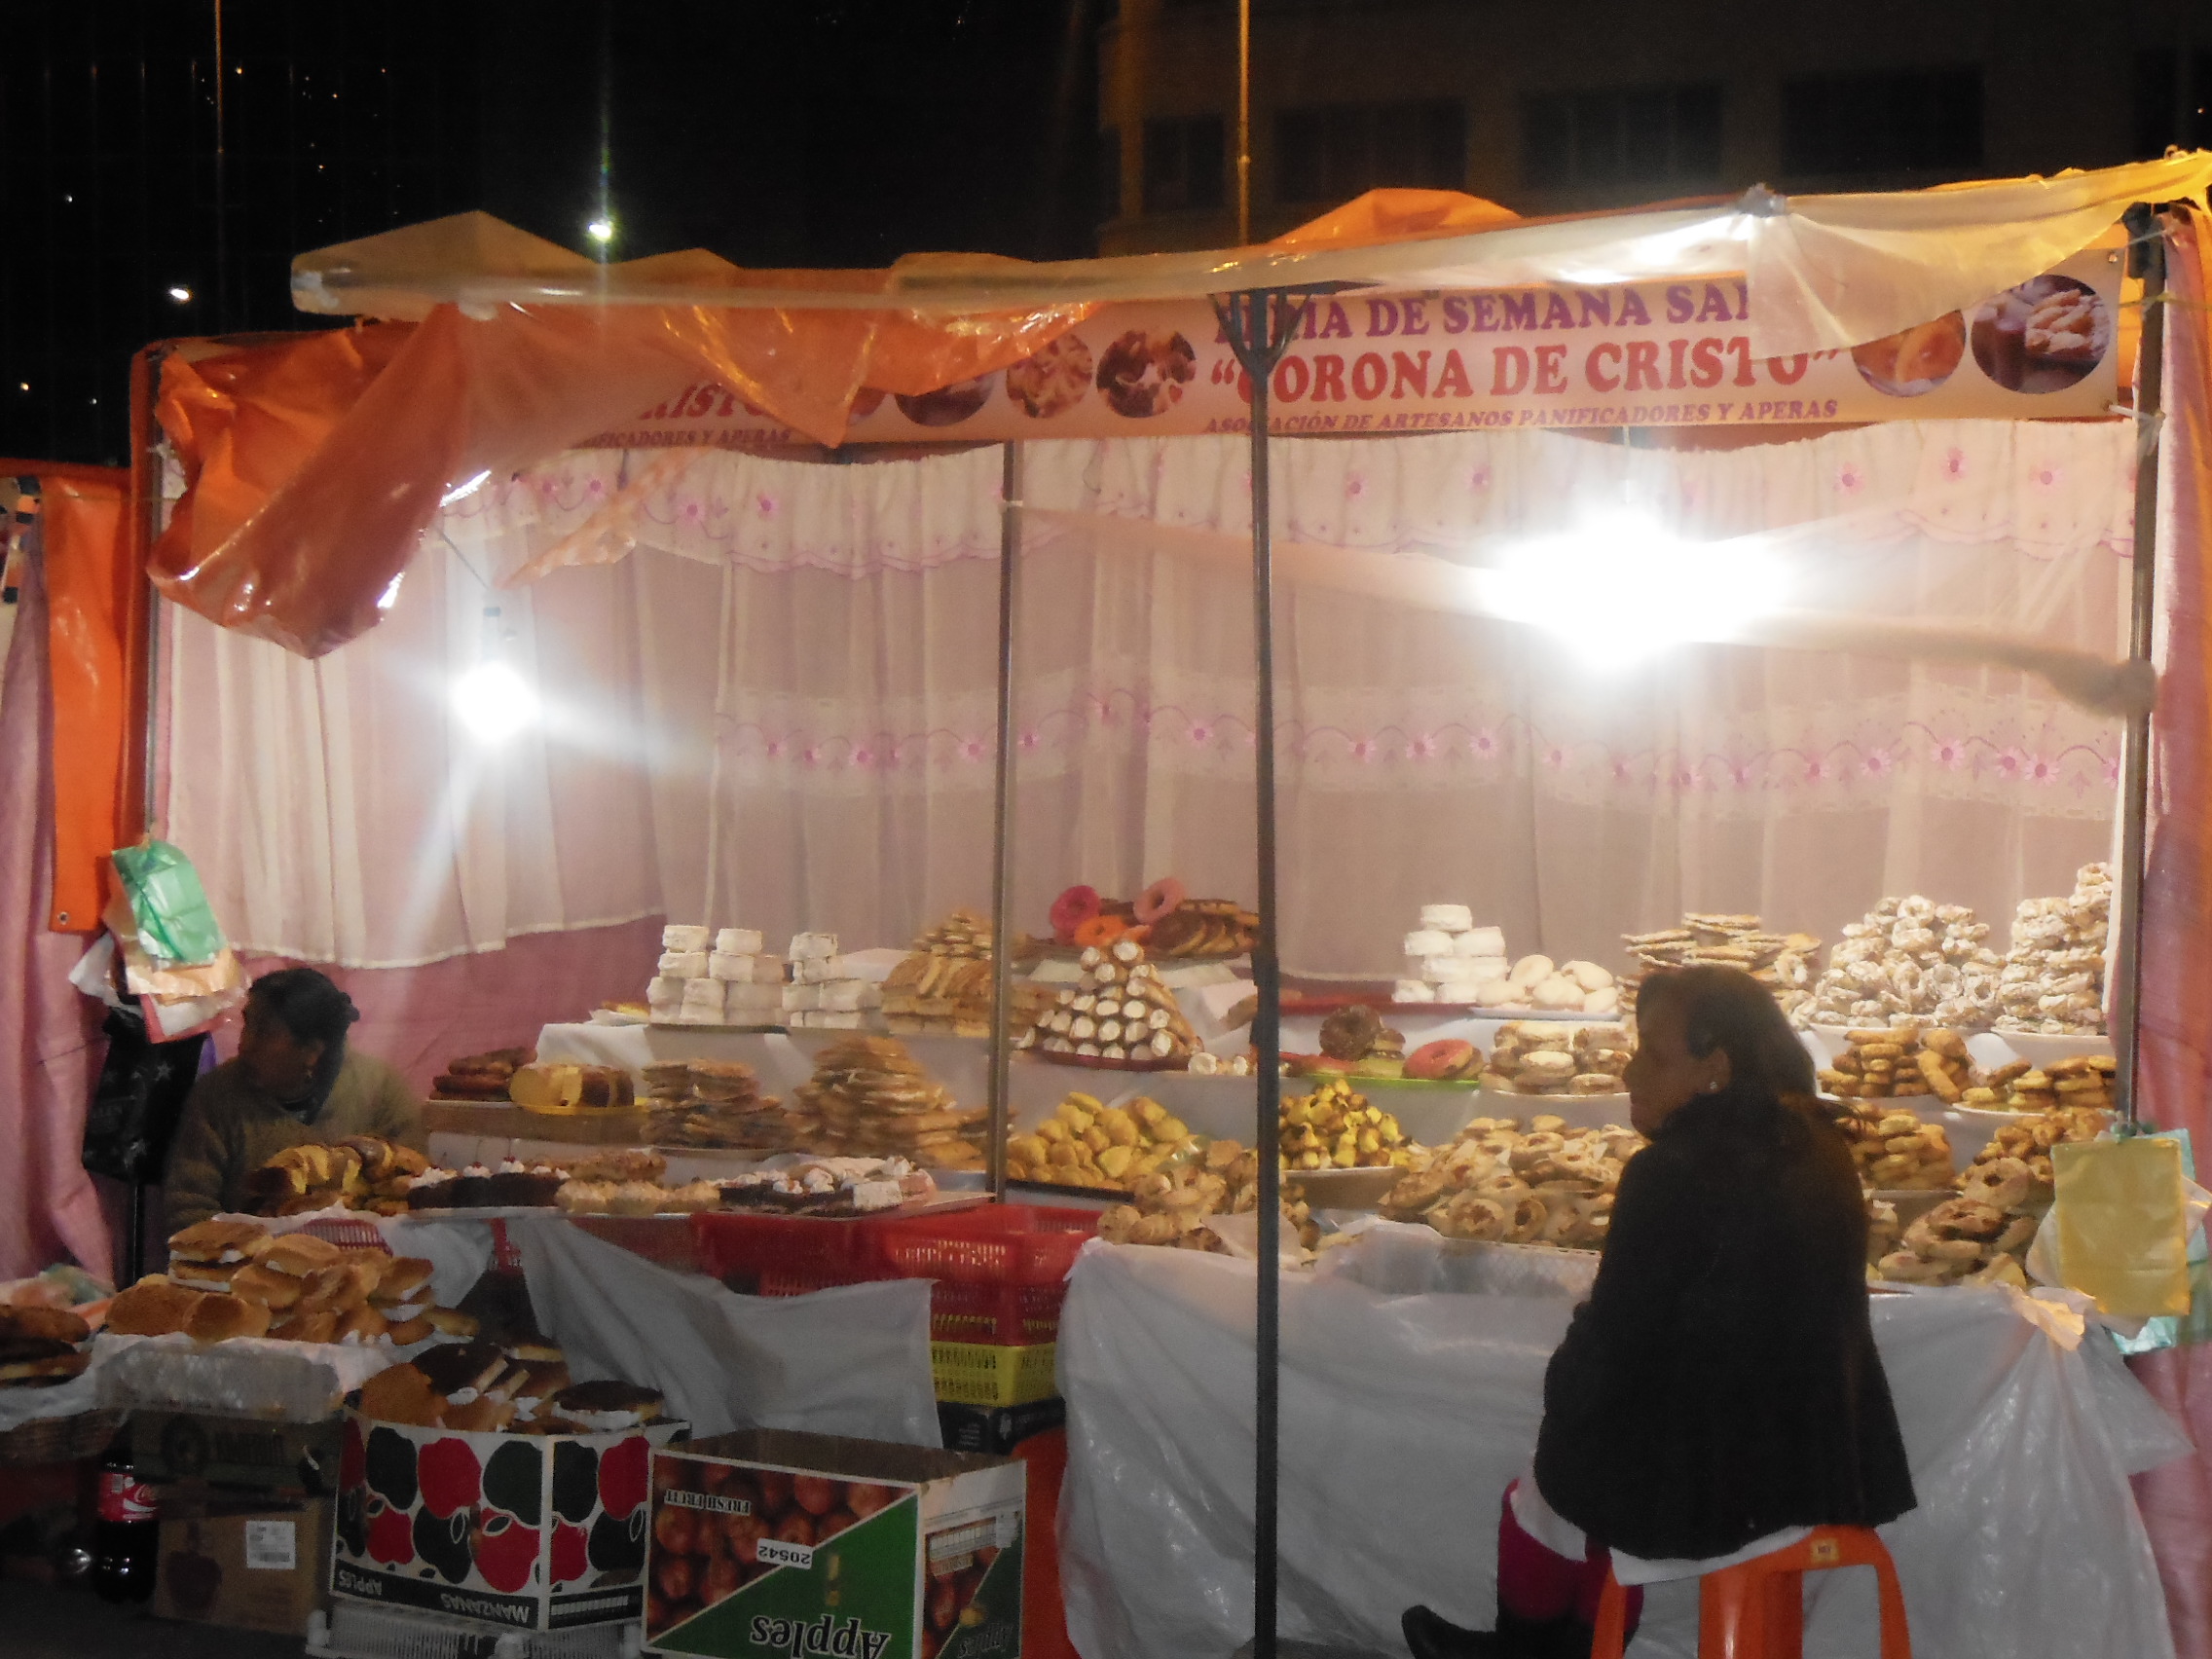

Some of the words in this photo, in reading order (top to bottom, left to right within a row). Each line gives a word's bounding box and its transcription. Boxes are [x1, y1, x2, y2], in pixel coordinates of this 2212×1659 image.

[1366, 296, 1430, 337] DE
[1443, 287, 1652, 335] SEMANA
[1490, 343, 1568, 395] DE
[1204, 410, 1340, 434] ASOACIÓN
[1344, 413, 1374, 431] DE
[1379, 410, 1513, 430] ARTESANOS
[1519, 401, 1711, 426] PANIFICADORES
[1718, 402, 1735, 424] Y
[1738, 399, 1838, 423] APERAS
[664, 1489, 705, 1510] FRUIT
[706, 1494, 752, 1517] FRESH
[757, 1544, 811, 1565] 20542
[440, 1594, 530, 1624] MANZANAS
[750, 1612, 893, 1659] Apples
